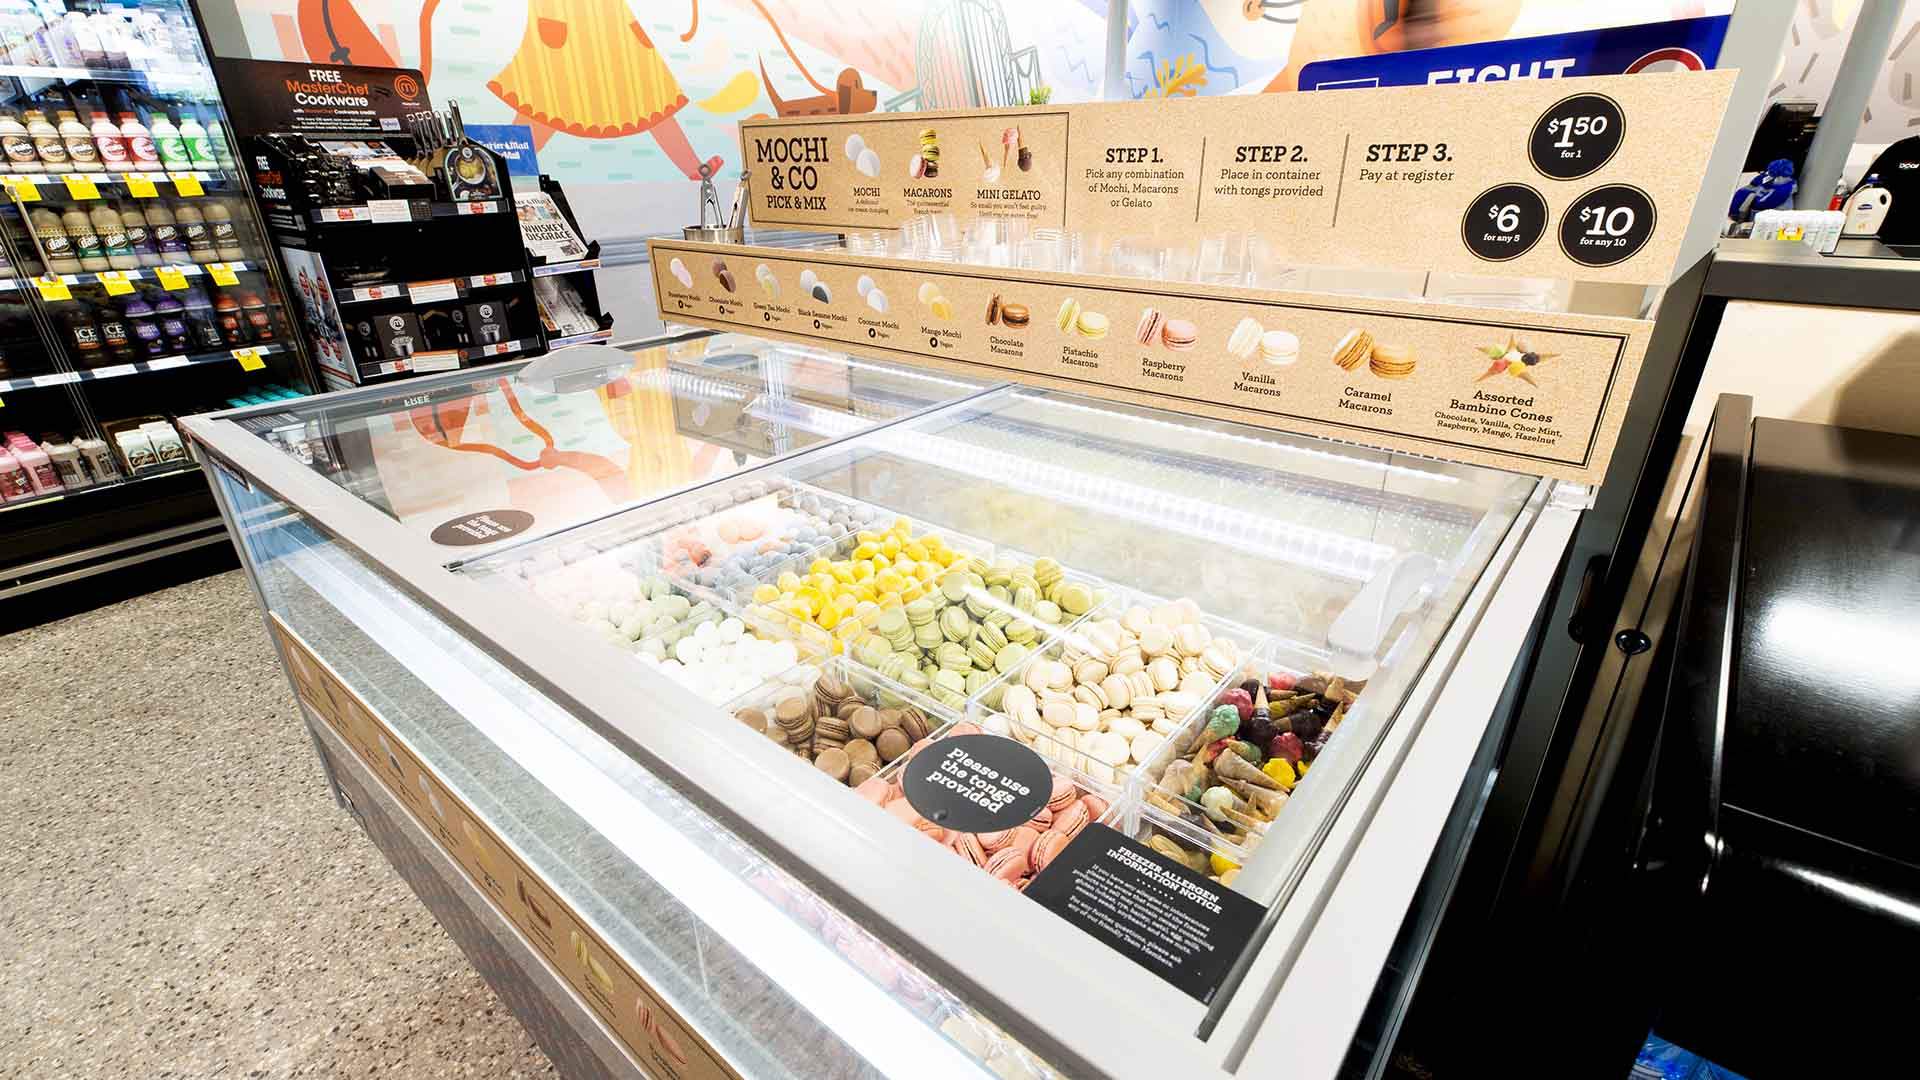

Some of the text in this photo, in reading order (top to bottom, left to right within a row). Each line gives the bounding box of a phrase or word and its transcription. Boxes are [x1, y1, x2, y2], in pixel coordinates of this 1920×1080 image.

[308, 69, 342, 82] FREE
[286, 80, 368, 95] MasterChef
[295, 92, 368, 106] Cookware
[756, 137, 829, 162] MOCHI
[1105, 148, 1164, 163] STEP 1.
[1235, 146, 1308, 163] STEP 2.
[1366, 144, 1454, 162] STEP 3.
[1560, 150, 1582, 160] for 1
[771, 166, 818, 190] & CO
[1086, 168, 1184, 181] Pick any combination
[1220, 168, 1320, 180] Place in container
[1360, 168, 1454, 184] Pay at register
[854, 187, 880, 196] MOCHI
[904, 188, 952, 198] MACARONS
[977, 189, 1040, 200] MINI GELATO
[1088, 182, 1178, 196] of Mochi, Macarons
[1214, 184, 1324, 200] with tongs provided
[767, 196, 826, 210] PICK & MIX
[1110, 197, 1152, 208] or Gelato
[1488, 204, 1520, 232] $6
[1579, 206, 1634, 236] $10
[522, 223, 564, 233] WHISKEY
[525, 230, 572, 241] DISGRACE
[1483, 233, 1520, 245] for any 5
[1580, 236, 1626, 250] for any 10
[858, 318, 900, 330] Coconut Mochi
[921, 326, 962, 339] Mango Mochi
[989, 336, 1024, 348] Chocolate
[990, 346, 1024, 358] Macarons
[1063, 346, 1098, 360] Pistachio
[1062, 356, 1098, 368] Macarons
[1142, 358, 1186, 374] Raspberry
[1142, 368, 1184, 382] Macarons
[1241, 372, 1276, 386] Vanilla
[1233, 382, 1281, 398] Macarons
[1344, 386, 1392, 402] Caramel
[1472, 390, 1534, 408] Assorted
[1338, 398, 1393, 416] Macarons
[1450, 398, 1553, 424] Bambino Cones
[1434, 410, 1563, 438] Chocolate, Vanilla, Choc Mint,
[1437, 420, 1556, 446] Raspberry, Mango, Hazelnut
[946, 747, 1031, 796] Please use
[940, 759, 1016, 805] the tongs
[926, 770, 1004, 814] provided
[1106, 848, 1222, 914] INFORMATION NOTICE
[1118, 846, 1220, 903] FREEZER ALLERGEN
